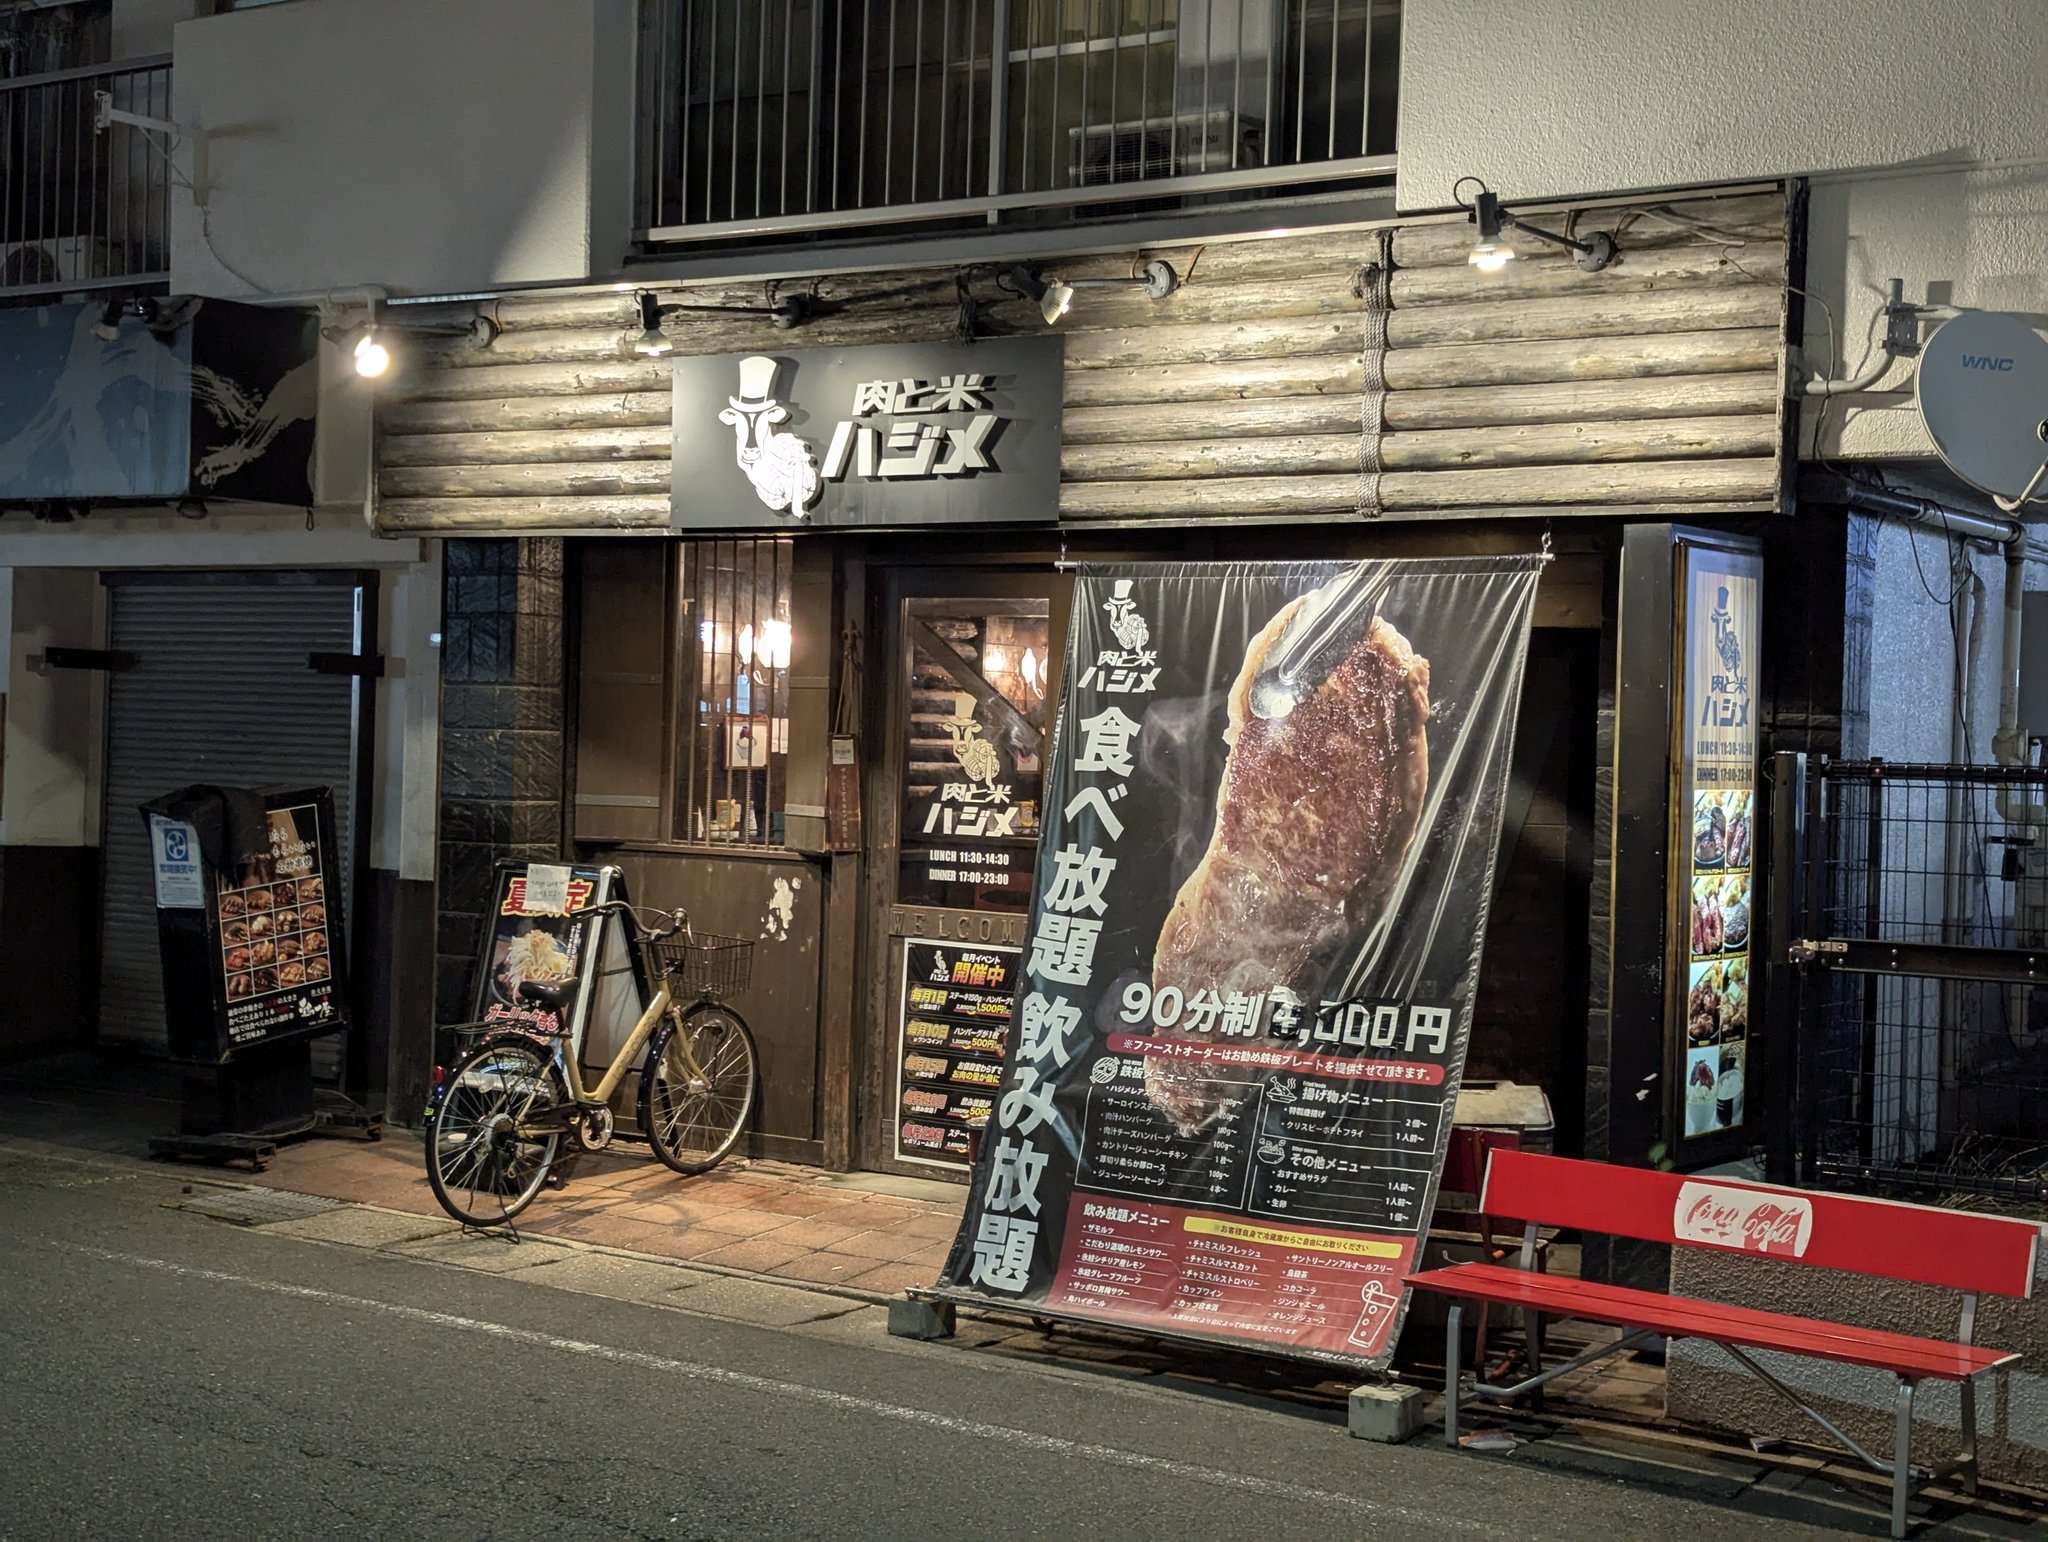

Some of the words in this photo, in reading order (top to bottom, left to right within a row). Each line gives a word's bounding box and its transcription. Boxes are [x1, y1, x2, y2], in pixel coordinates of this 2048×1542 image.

[1962, 354, 2014, 371] WNC
[851, 374, 985, 416] 肉と米
[820, 415, 999, 478] ハジメ
[1097, 650, 1157, 667] 肉と米
[1077, 666, 1161, 693] ハジメ
[1711, 675, 1748, 694] 肉と米
[1701, 696, 1751, 728] ハジメ
[941, 783, 1011, 803] 肉と米
[923, 803, 1018, 837] ハジメ
[929, 850, 957, 862] LUNCH
[959, 851, 1009, 865] 11:30-14:30
[929, 868, 957, 882] DINNER
[959, 870, 1009, 885] 17:00-23:00
[892, 911, 1027, 944] WELCOM
[951, 961, 1005, 987] 開催中
[1119, 1065, 1187, 1082] 鉄板メニュー
[1110, 1085, 1171, 1099] ハジメレアステーキ
[1302, 1087, 1383, 1106] 揚げ物メニュー
[1103, 1127, 1172, 1143] 肉汁チーズハンバーグ
[1286, 1120, 1364, 1137] クリスピーポテトフライ
[1101, 1141, 1188, 1160] カントリージューシーチキン
[1290, 1154, 1371, 1172] その他メニュー
[1098, 1169, 1165, 1186] ジューシーソーセージ
[1277, 1169, 1329, 1184] おすすめサラダ
[1274, 1184, 1297, 1194] カレー
[1083, 1203, 1170, 1226] 飲み放題メニュー
[1192, 1239, 1262, 1258] チャミスルフレッシュ
[1189, 1254, 1258, 1272] チャミスルマスカット
[1186, 1269, 1261, 1287] チャミスルストロベリー
[1182, 1284, 1224, 1298] カップワイン
[1282, 1283, 1317, 1295] コカコーラ
[1272, 1311, 1326, 1325] オレンジジュース
